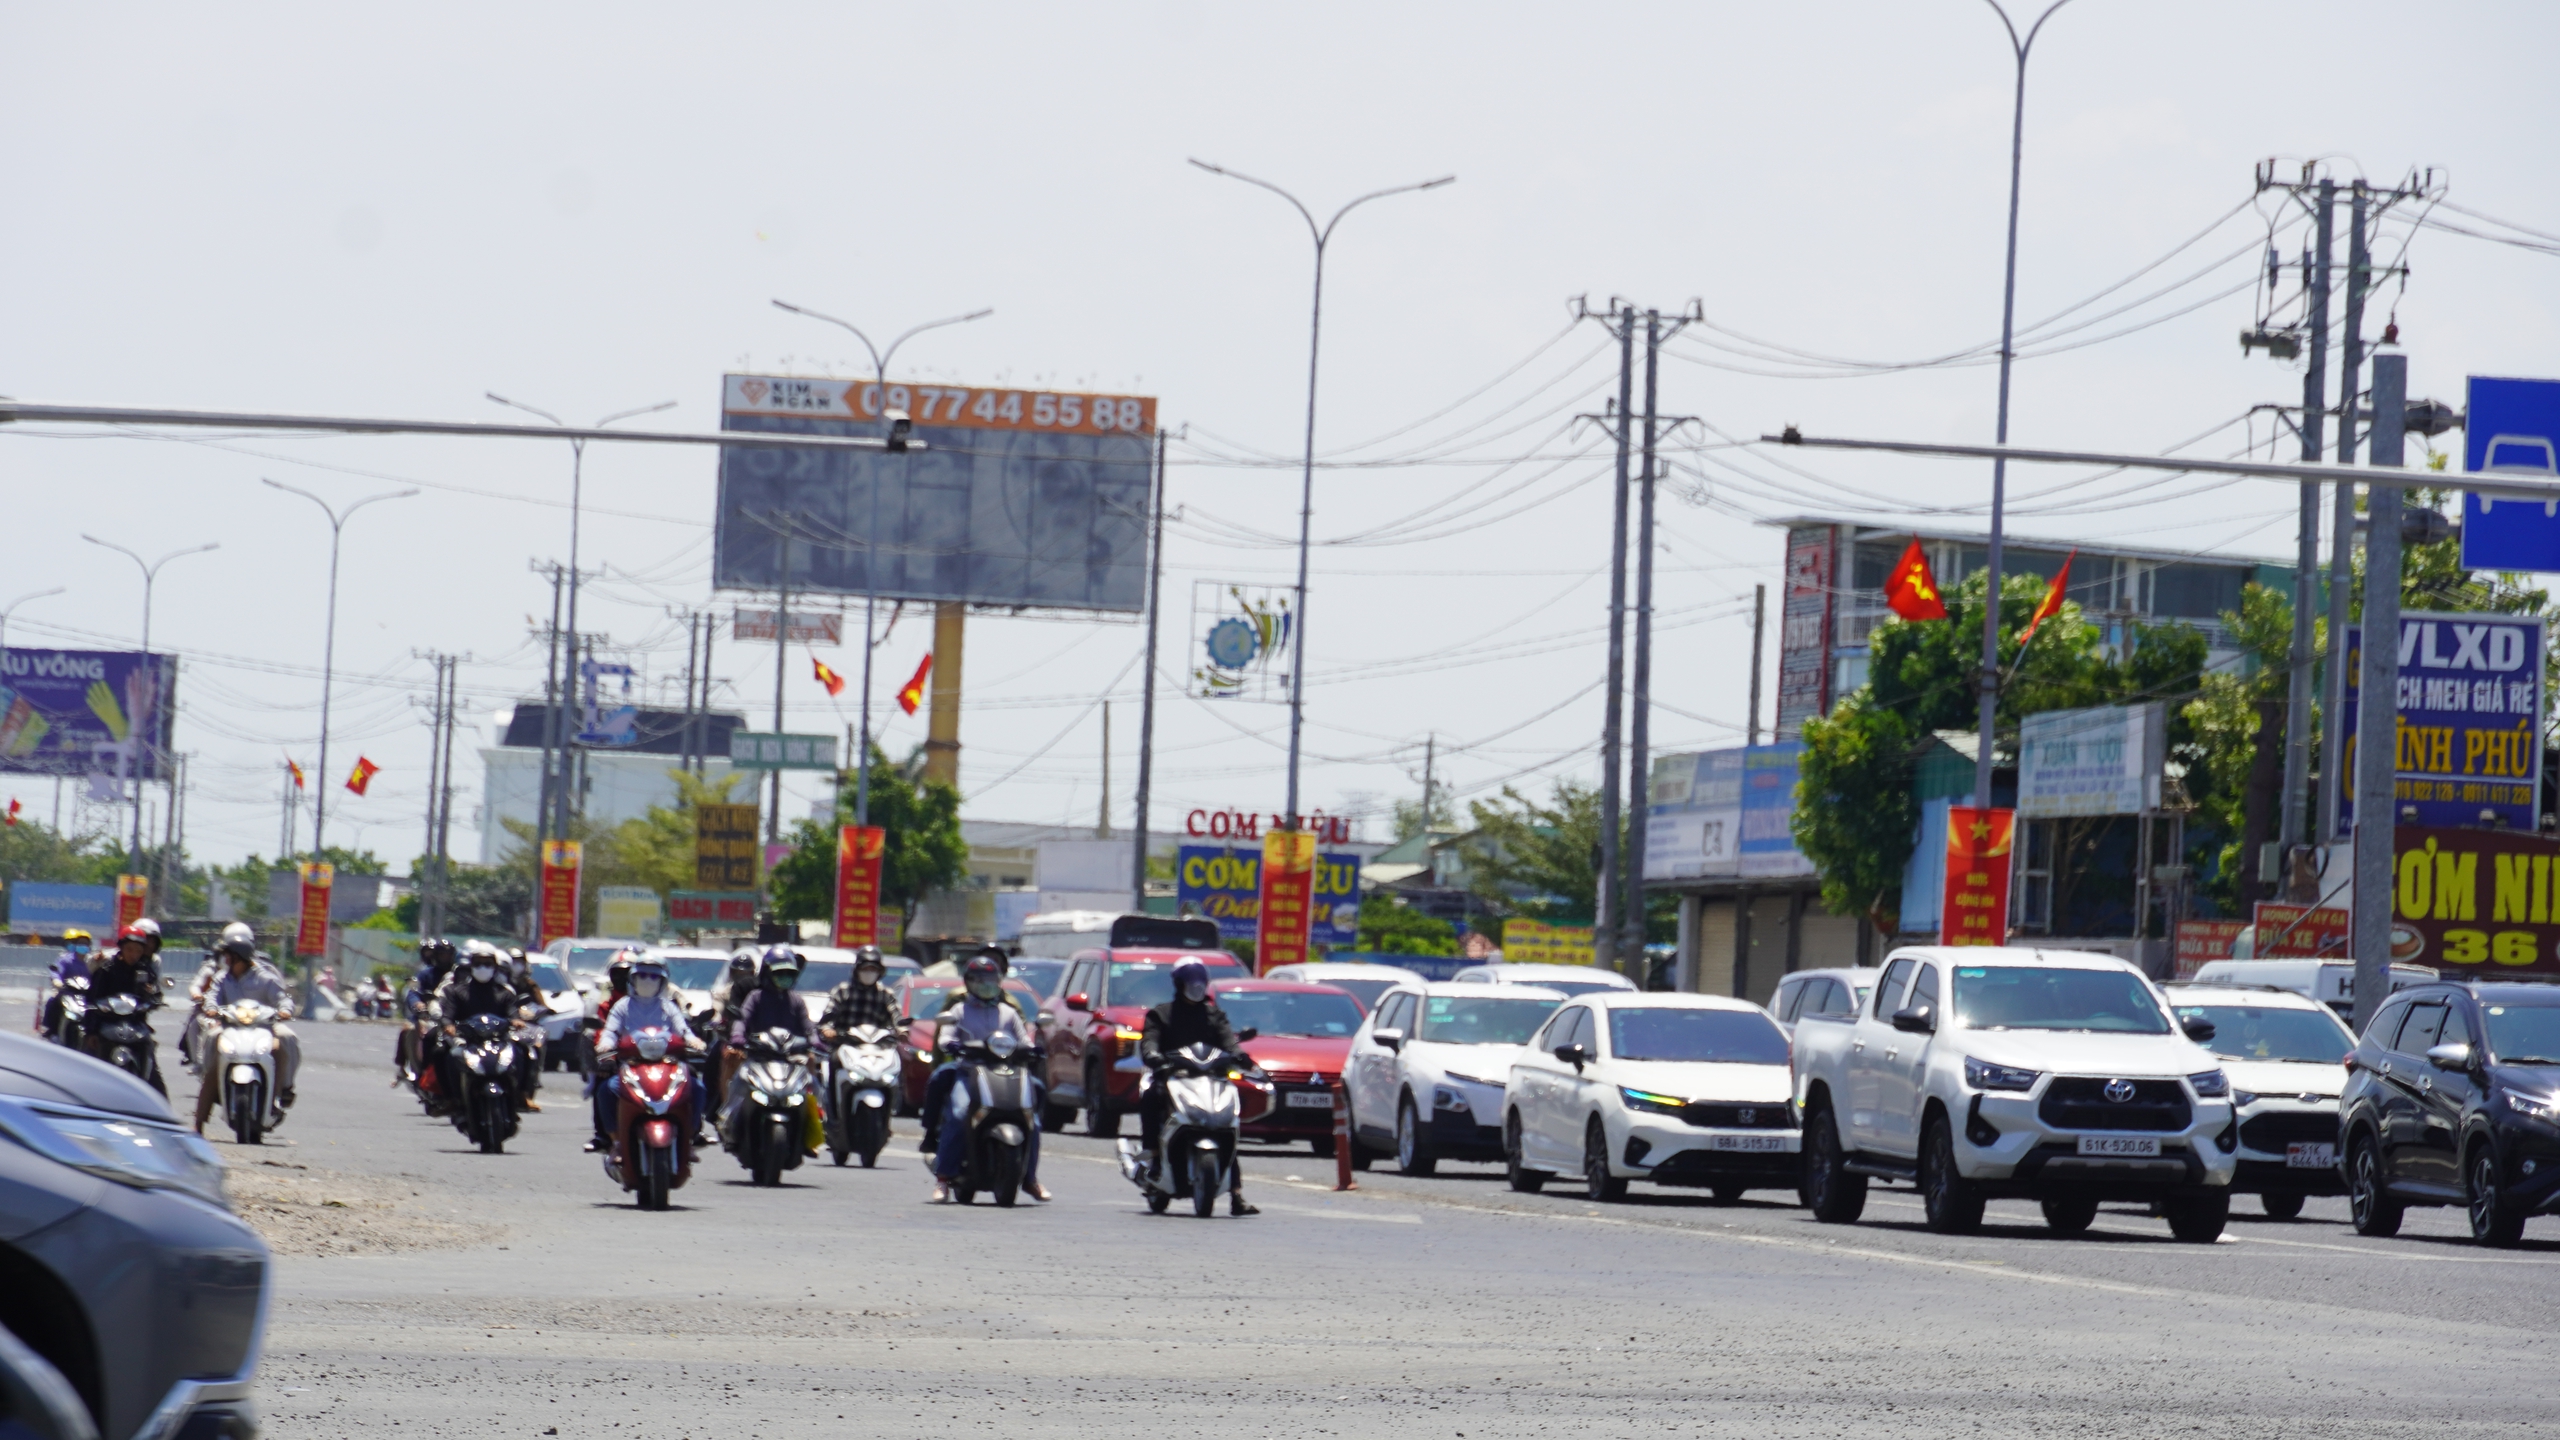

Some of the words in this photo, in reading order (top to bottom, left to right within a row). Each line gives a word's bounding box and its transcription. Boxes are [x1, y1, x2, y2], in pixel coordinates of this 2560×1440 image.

[860, 384, 911, 417] 09
[918, 387, 970, 421] 77
[972, 390, 1023, 424] 44
[1032, 394, 1083, 428] 55
[1091, 397, 1143, 431] 88
[2425, 678, 2469, 711] MEN
[2473, 674, 2504, 713] GIÁ
[2509, 671, 2535, 714] RẺ
[2463, 717, 2532, 777] PHÚ
[1187, 806, 1258, 841] CƠM
[1183, 856, 1258, 891] CƠM
[2392, 835, 2478, 922] ƠM
[2493, 850, 2560, 924] NI
[2260, 908, 2299, 921] HONDA
[2309, 912, 2327, 925] TAY
[2329, 913, 2346, 926] GA
[2207, 940, 2224, 955] XE
[2292, 930, 2314, 948] XE
[2442, 928, 2538, 966] 36
